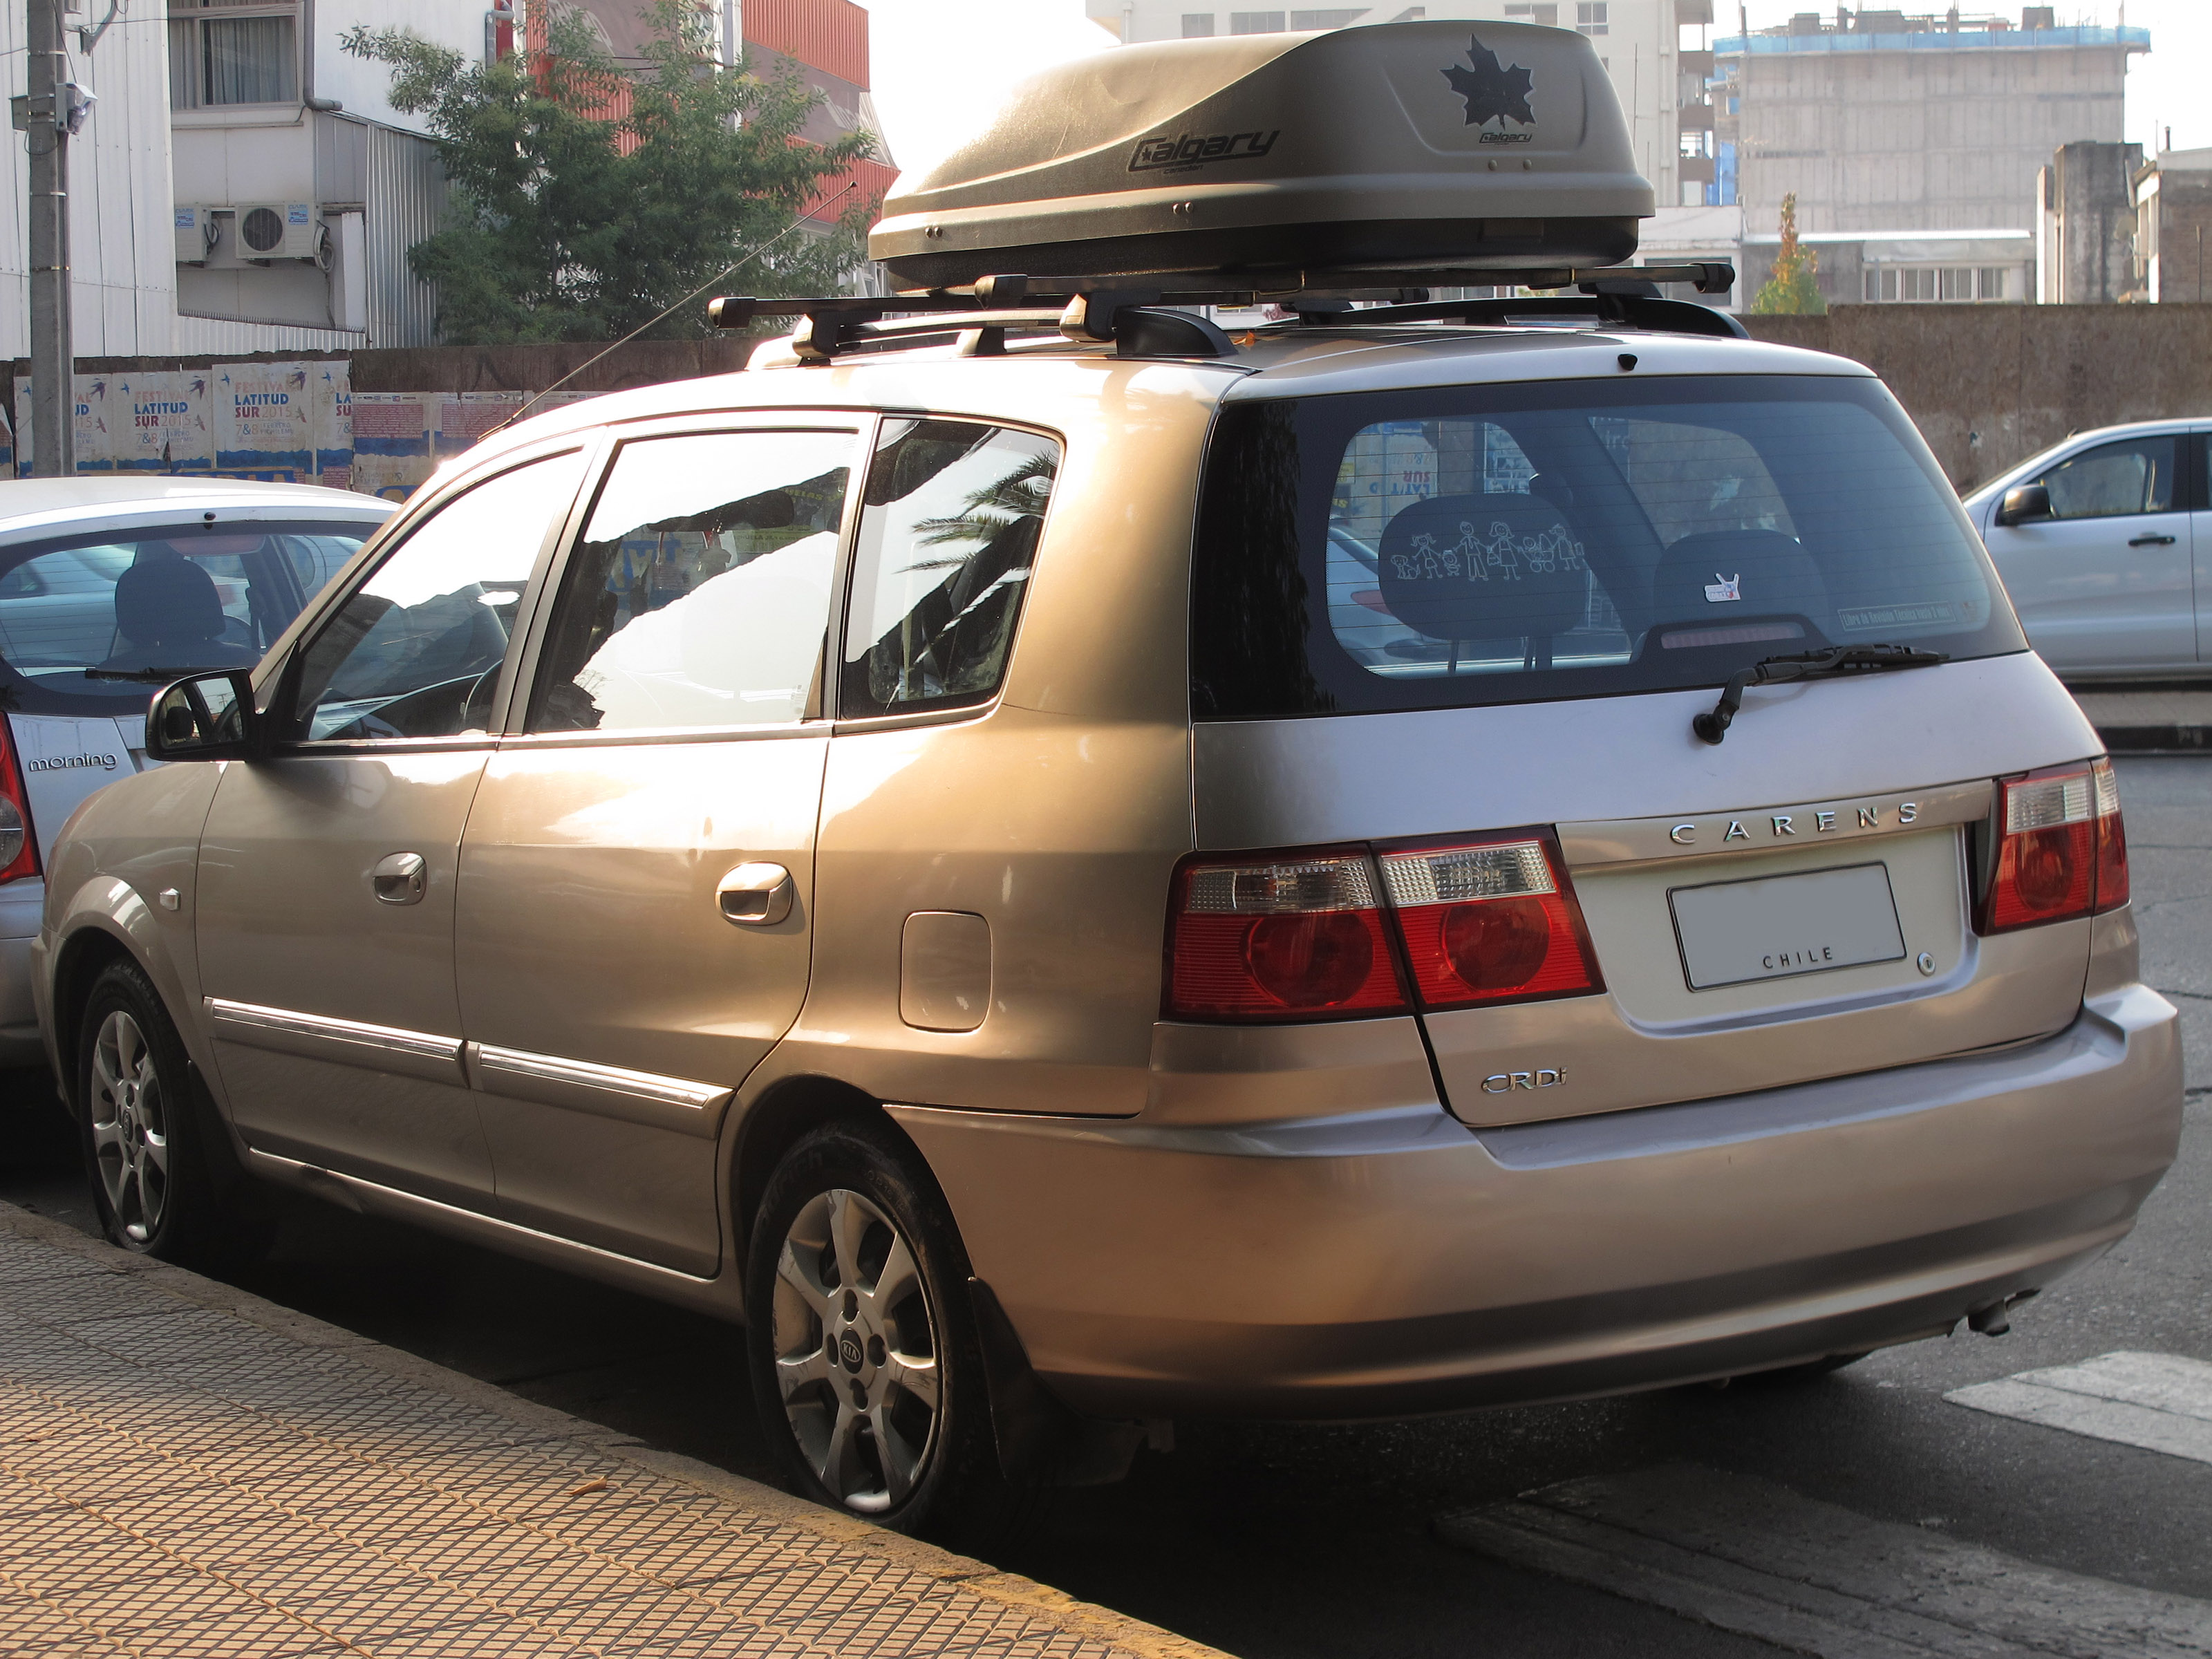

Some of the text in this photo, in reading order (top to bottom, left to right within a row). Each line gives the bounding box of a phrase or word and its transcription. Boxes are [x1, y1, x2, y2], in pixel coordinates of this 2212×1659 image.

[1479, 132, 1533, 143] Calgary
[1128, 130, 1280, 172] Calgary
[234, 393, 289, 405] LATITUD
[134, 402, 188, 414] LATITUD
[235, 406, 292, 418] SUR 2015
[135, 415, 191, 427] SUR 2015
[1403, 471, 1431, 482] SUR
[1369, 482, 1430, 496] LATITD
[30, 752, 118, 771] morning
[1671, 803, 1918, 844] CARENS
[1763, 947, 1834, 969] CHILE
[1481, 1067, 1568, 1095] CRDi
